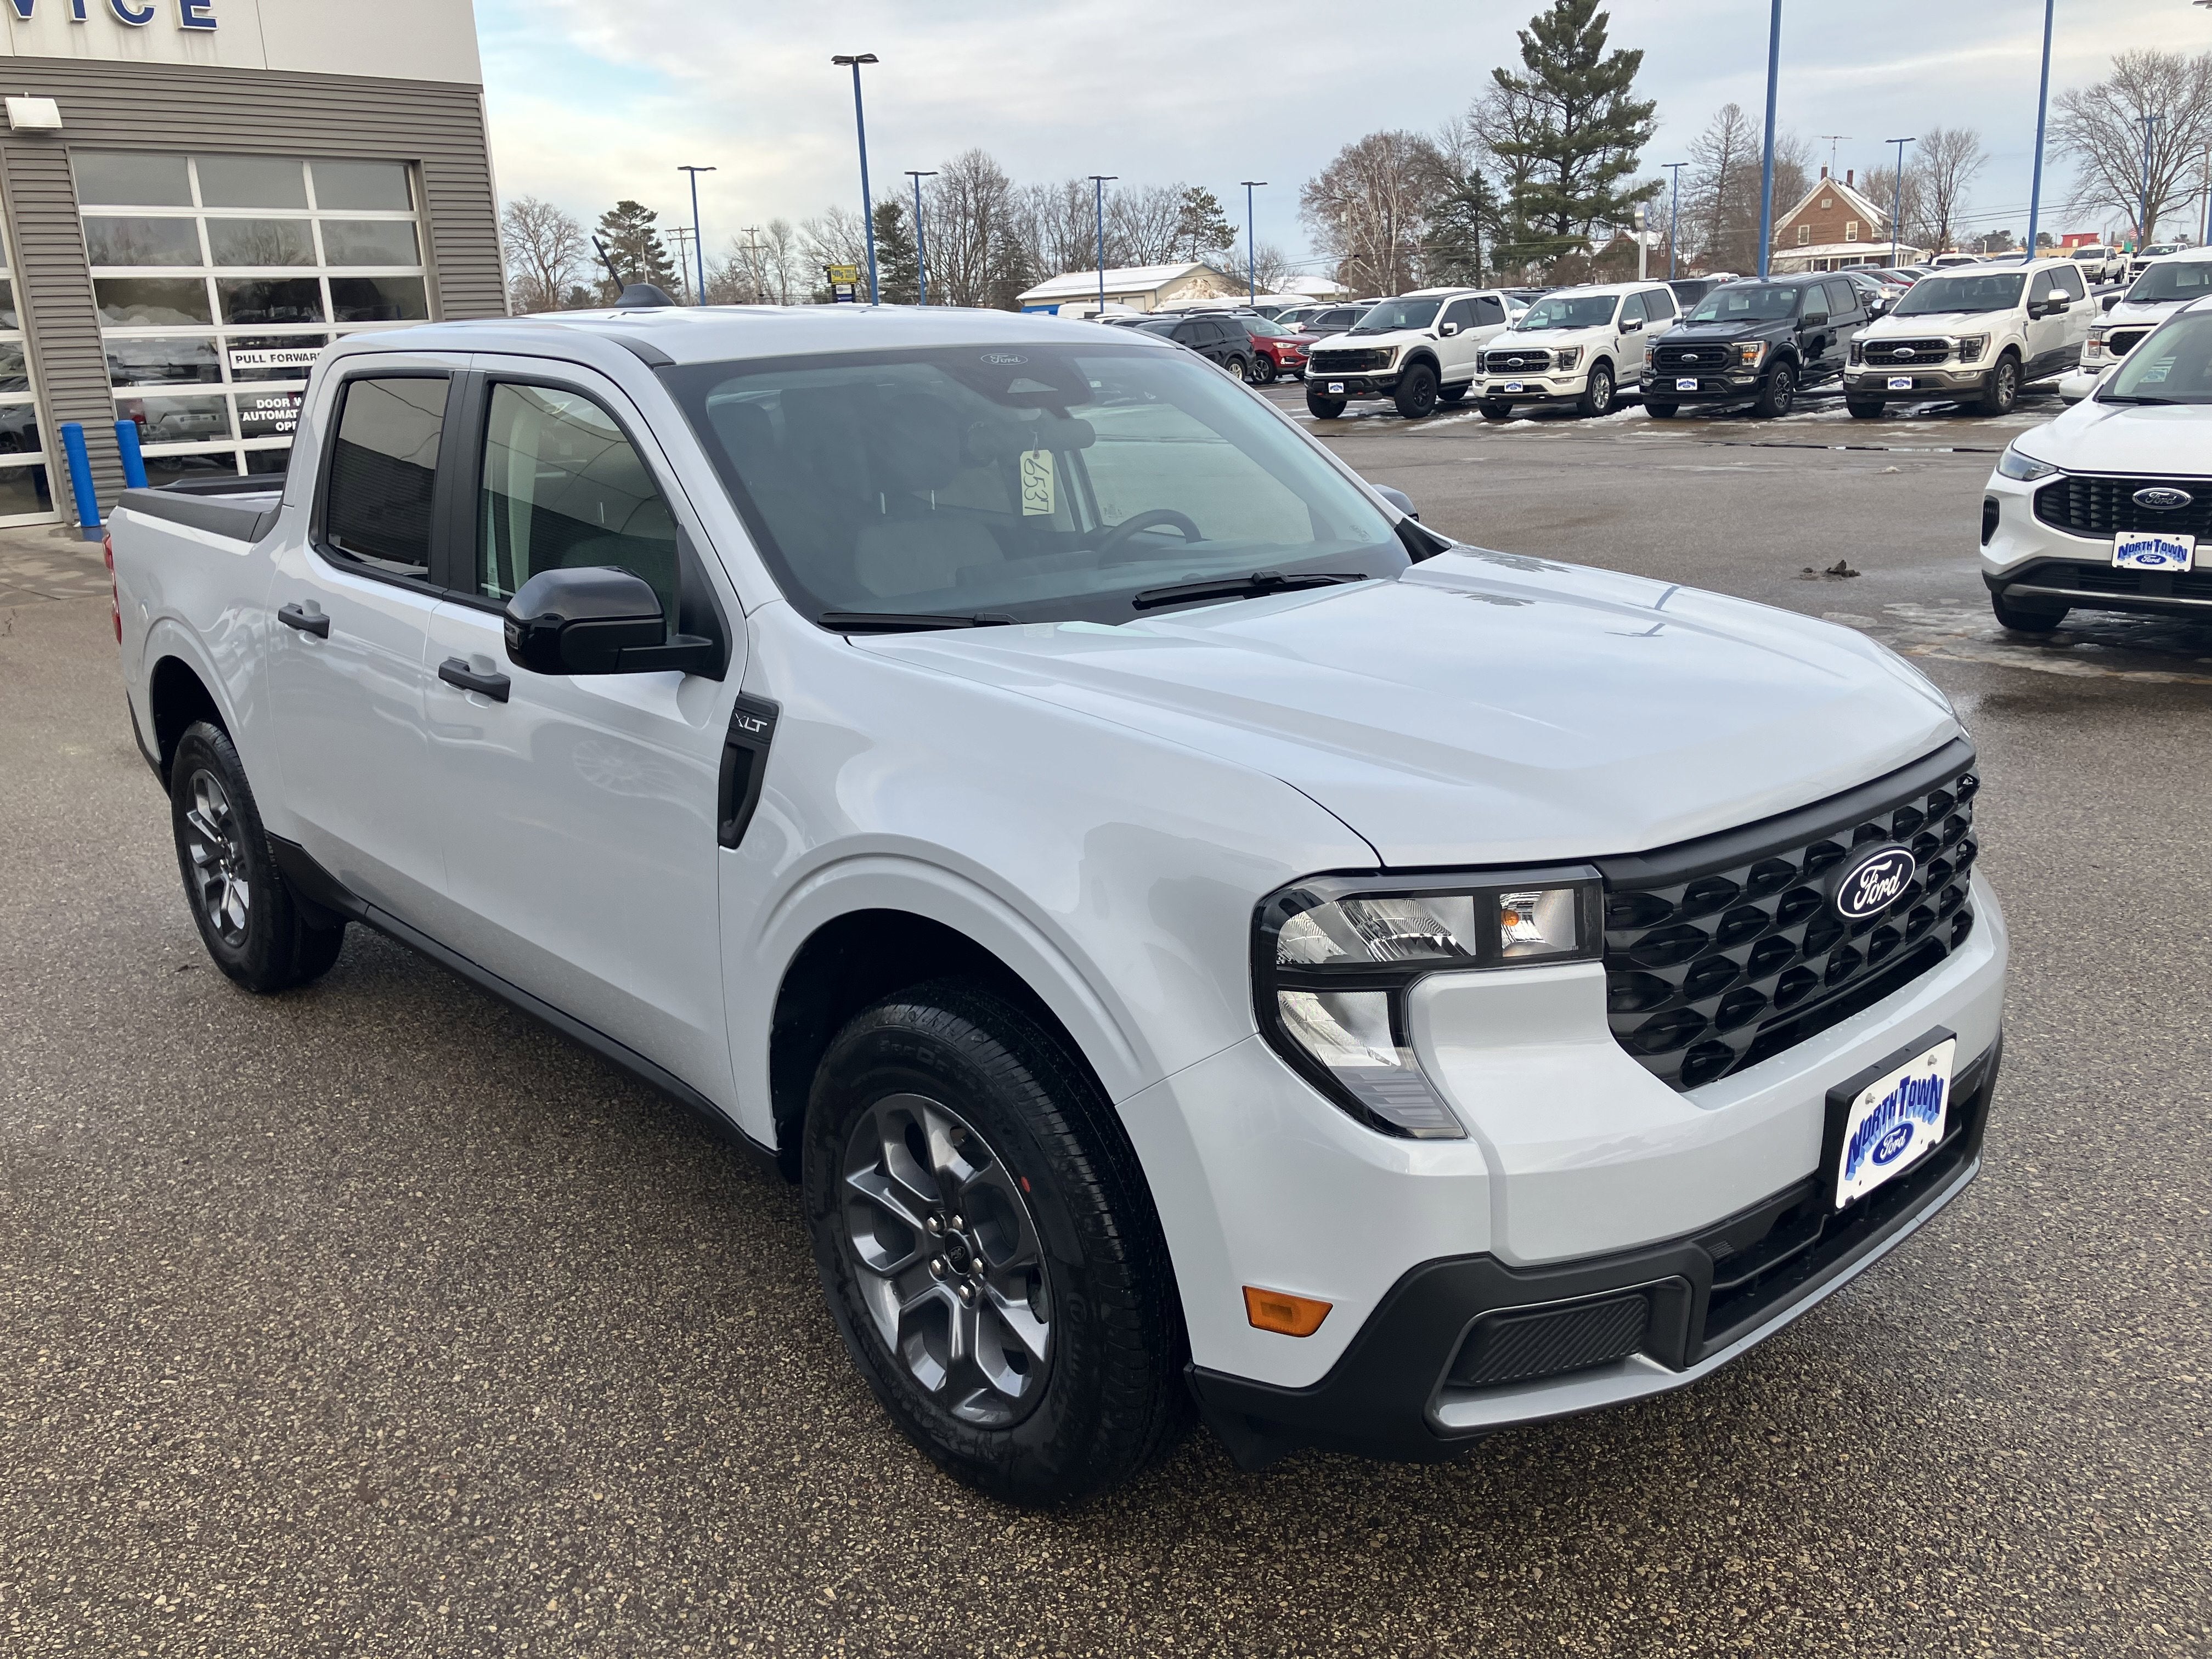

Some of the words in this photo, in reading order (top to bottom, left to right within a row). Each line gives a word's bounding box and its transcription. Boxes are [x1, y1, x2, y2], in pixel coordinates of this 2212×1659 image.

[235, 354, 266, 364] PULL
[270, 353, 320, 363] FORWAR
[990, 354, 1022, 363] Ford
[256, 398, 290, 409] DOOR
[242, 409, 300, 421] AUTOMAT
[1023, 458, 1049, 512] 6537
[2145, 492, 2177, 505] Ford
[2141, 555, 2160, 563] Ford
[735, 713, 768, 732] XLT
[1853, 859, 1903, 911] Ford
[1880, 1128, 1908, 1160] Ford
